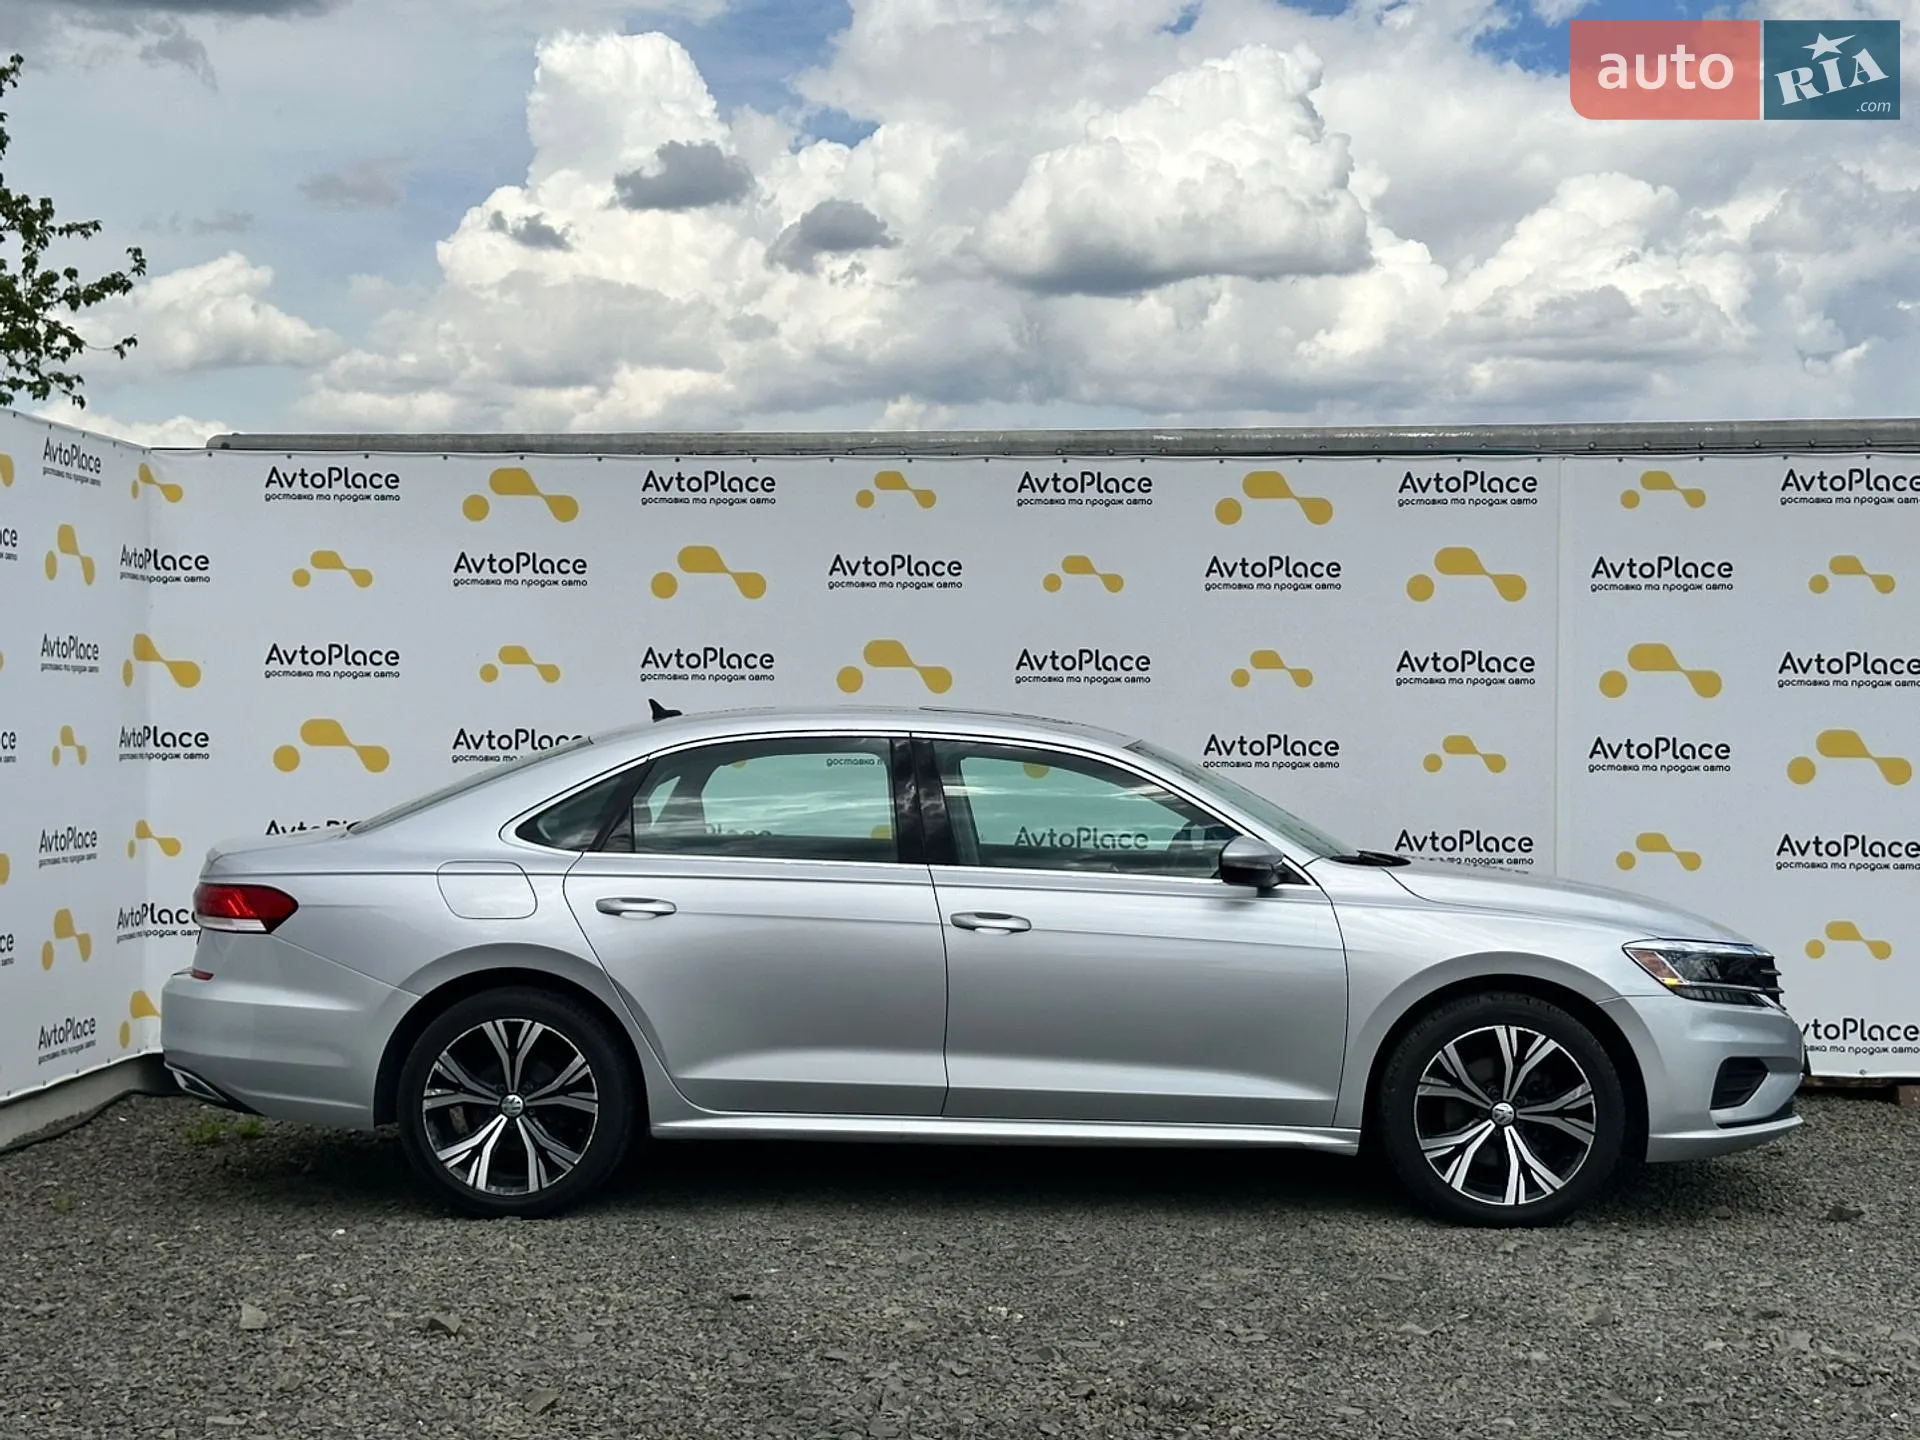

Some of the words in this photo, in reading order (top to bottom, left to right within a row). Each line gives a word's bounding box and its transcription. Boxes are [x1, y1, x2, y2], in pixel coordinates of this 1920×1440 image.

[43, 436, 101, 474] AvtoPlace
[265, 466, 400, 490] AvtoPlace
[642, 470, 776, 493] AvtoPlace
[1017, 471, 1153, 494] AvtoPlace
[1398, 470, 1537, 494] AvtoPlace
[1781, 468, 1920, 492] AvtoPlace
[265, 493, 314, 502] доставка
[333, 494, 372, 503] продаж
[641, 497, 690, 506] доставка
[709, 498, 747, 506] продаж
[1016, 498, 1066, 507] доставка
[1086, 499, 1124, 507] продаж
[1397, 498, 1448, 507] доставка
[1468, 498, 1508, 507] продаж
[1780, 497, 1833, 506] доставка
[1854, 496, 1894, 505] продаж
[120, 544, 209, 571] AvtoPlace
[453, 552, 587, 575] AvtoPlace
[828, 554, 962, 577] AvtoPlace
[1205, 555, 1341, 578] AvtoPlace
[1591, 556, 1733, 579] AvtoPlace
[453, 578, 502, 587] доставка
[521, 579, 559, 588] продаж
[828, 581, 877, 590] доставка
[896, 581, 934, 590] продаж
[936, 581, 962, 589] авто
[1204, 583, 1254, 592] доставка
[1274, 583, 1312, 592] продаж
[1591, 584, 1642, 592] доставка
[1663, 583, 1703, 592] продаж
[41, 634, 99, 660] AvtoPlace
[265, 643, 400, 666] AvtoPlace
[640, 647, 774, 670] AvtoPlace
[1016, 648, 1150, 672] AvtoPlace
[1396, 650, 1535, 673] AvtoPlace
[1778, 651, 1920, 675] AvtoPlace
[264, 670, 314, 679] доставка
[333, 671, 371, 680] продаж
[640, 674, 689, 682] доставка
[708, 674, 746, 683] продаж
[1015, 676, 1064, 684] доставка
[1083, 676, 1122, 685] продаж
[1395, 678, 1446, 686] доставка
[1466, 678, 1506, 686] продаж
[1777, 679, 1830, 688] доставка
[1851, 680, 1892, 689] продаж
[119, 725, 209, 748] AvtoPlace
[1204, 734, 1339, 757] AvtoPlace
[1589, 736, 1730, 760] AvtoPlace
[183, 752, 210, 760] авто
[1203, 761, 1252, 769] доставка
[1272, 761, 1310, 770] продаж
[1588, 764, 1639, 773] доставка
[1660, 765, 1700, 774] продаж
[39, 826, 97, 853] AvtoPlace
[1014, 827, 1148, 850] AvtoPlace
[1395, 829, 1534, 853] AvtoPlace
[1776, 833, 1920, 858] AvtoPlace
[1776, 861, 1828, 870] доставка
[1849, 863, 1890, 872] продаж
[38, 1016, 96, 1050] AvtoPlace
[1848, 1046, 1888, 1055] продаж
